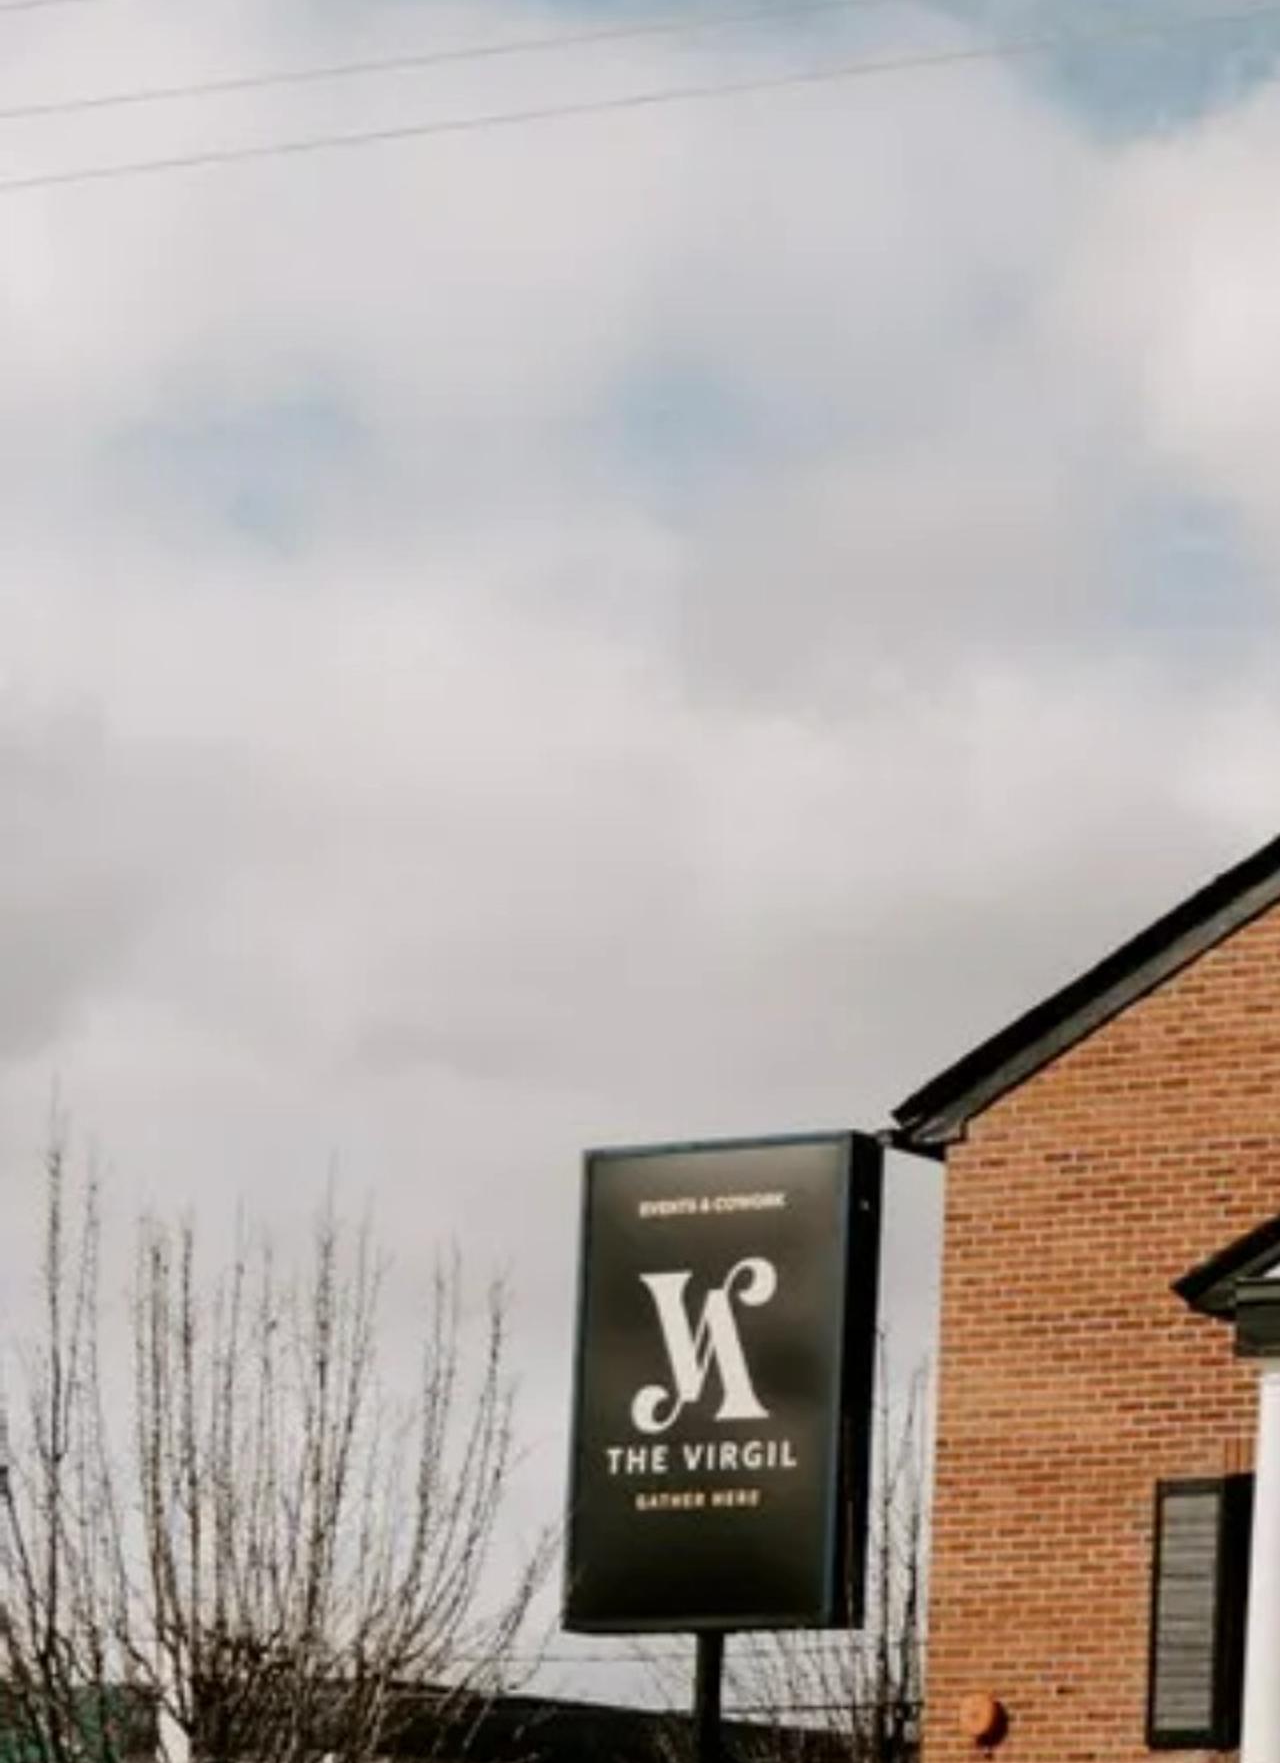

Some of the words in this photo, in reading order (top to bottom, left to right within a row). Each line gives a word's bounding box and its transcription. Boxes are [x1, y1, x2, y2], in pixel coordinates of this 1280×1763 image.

[606, 1444, 669, 1475] THE
[683, 1440, 797, 1471] VIRGIL
[635, 1492, 705, 1511] GATHER
[711, 1489, 760, 1507] HERE
